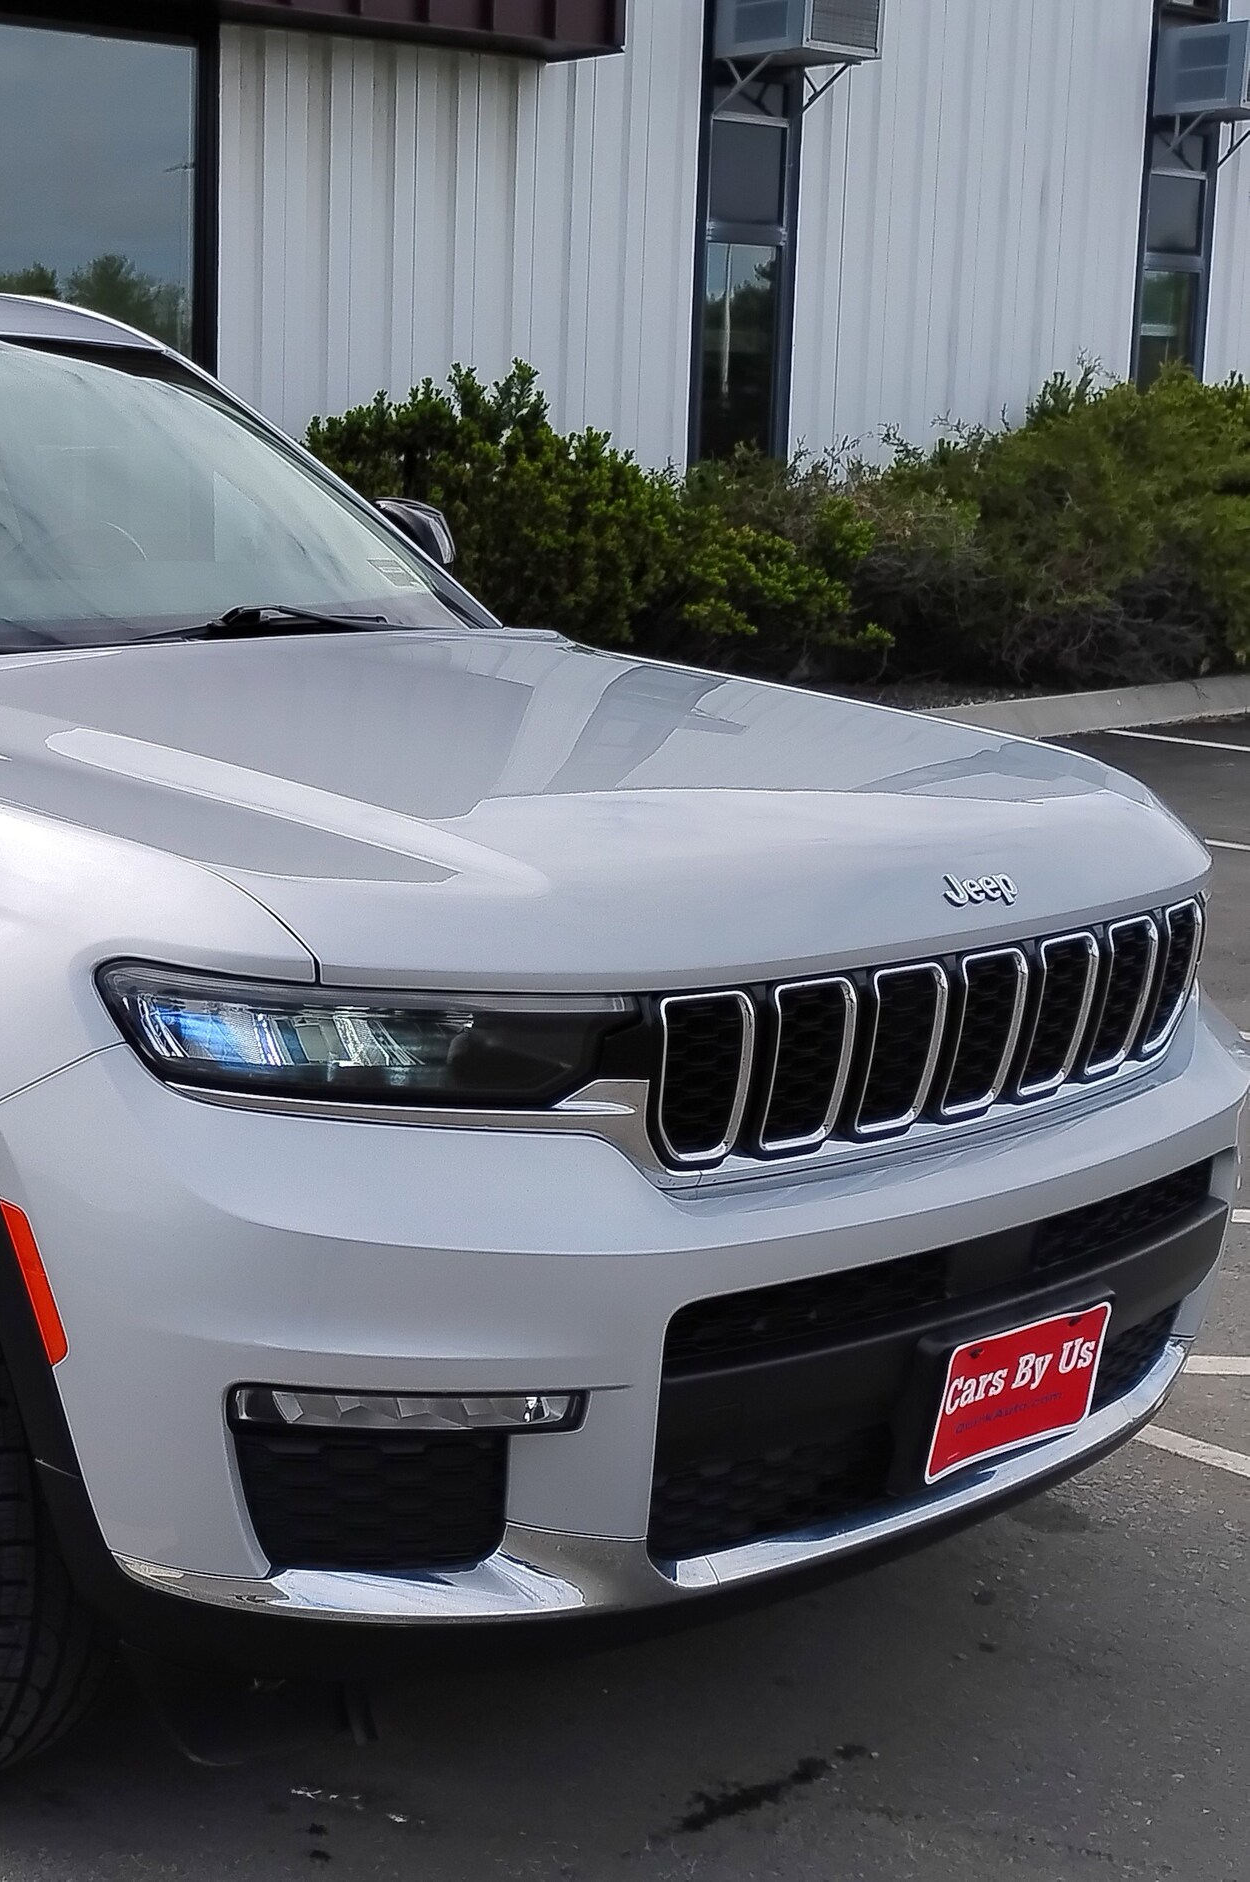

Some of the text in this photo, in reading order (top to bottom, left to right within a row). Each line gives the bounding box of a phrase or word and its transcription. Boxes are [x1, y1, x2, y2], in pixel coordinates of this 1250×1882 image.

[942, 873, 1018, 907] Jeep
[945, 1337, 1096, 1415] Cars By Us
